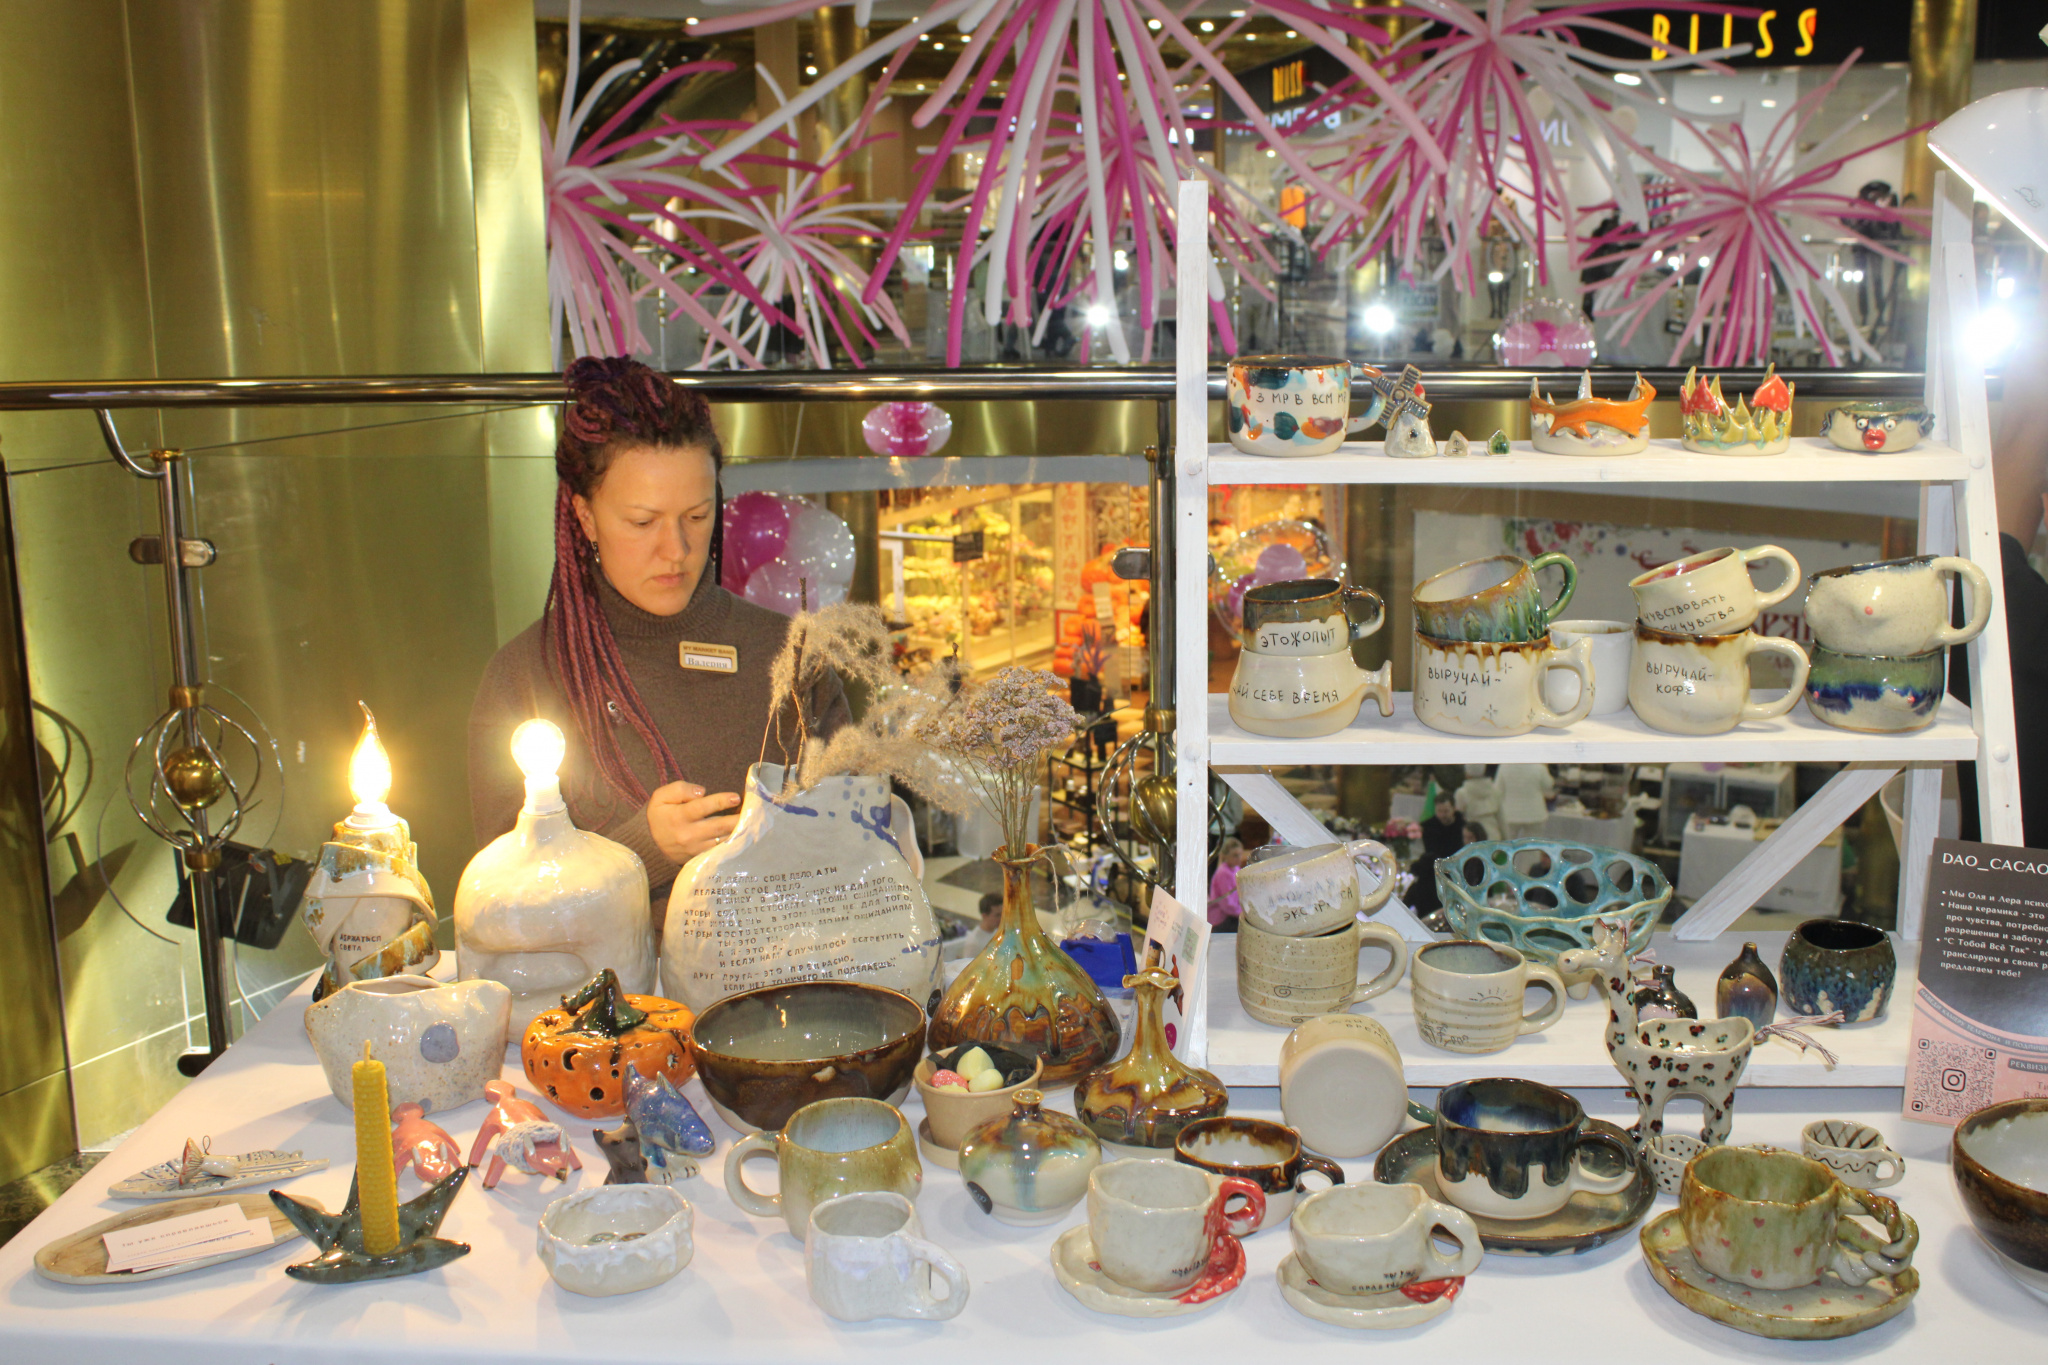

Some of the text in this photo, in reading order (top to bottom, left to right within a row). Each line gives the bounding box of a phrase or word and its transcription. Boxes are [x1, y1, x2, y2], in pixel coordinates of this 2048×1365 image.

[1643, 594, 1725, 622] ЧУВСТВОВАТЬ
[1679, 607, 1735, 632] ЧУВСТВА
[1441, 691, 1468, 707] ЧАЙ
[1942, 852, 2048, 875] DAO_CACAO
[1949, 889, 1965, 898] Мы
[1967, 891, 1986, 900] Оля
[1998, 895, 2021, 906] Лера
[1946, 914, 1963, 923] про
[1947, 901, 1973, 911] Наша
[1975, 905, 2019, 917] керамика
[2028, 912, 2045, 920] это
[1944, 926, 2000, 938] разрешения
[2011, 934, 2043, 946] заботу
[1957, 938, 1986, 949] Тобой
[1942, 949, 2000, 963] транслируем
[2011, 958, 2039, 968] своих
[1940, 961, 2022, 978] предлагаем тебе!
